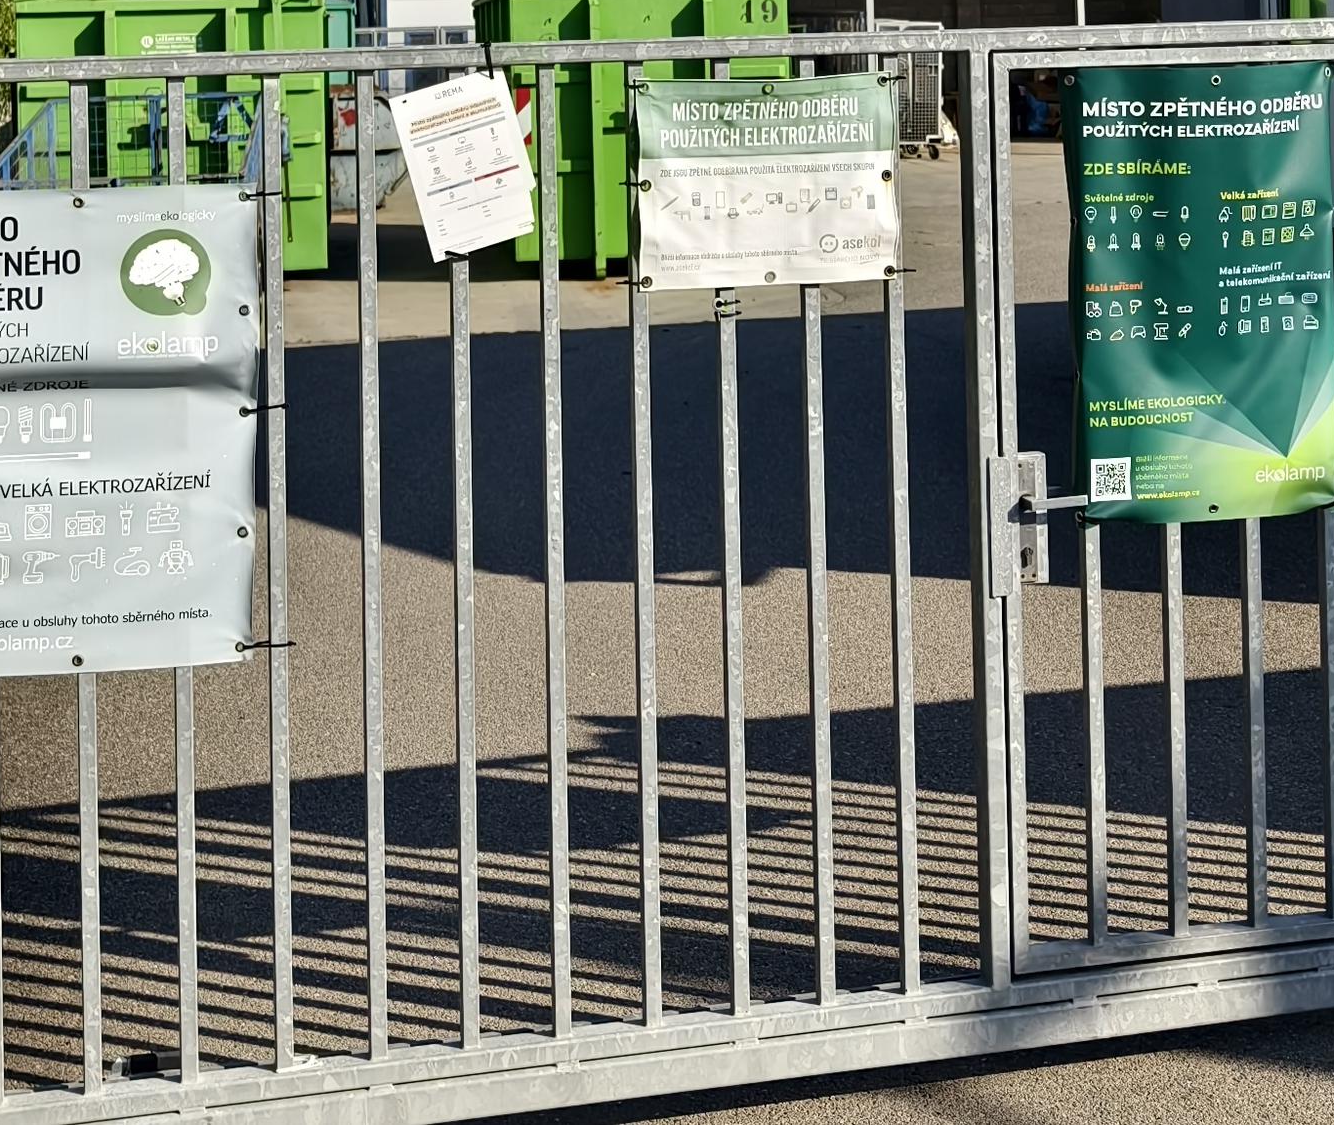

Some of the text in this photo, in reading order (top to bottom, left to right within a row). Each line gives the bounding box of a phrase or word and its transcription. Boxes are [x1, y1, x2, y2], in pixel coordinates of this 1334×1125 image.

[740, 0, 778, 23] 19
[442, 86, 463, 98] REMA
[672, 94, 859, 122] MÍSTO ZPĚTNÉHO ODBĚRU
[1082, 91, 1323, 118] MÍSTO ZPĚTNÉHO ODBĚRU
[660, 121, 874, 149] POUŽITÝCH ELEKTROZAŘÍZENÍ
[1082, 115, 1300, 138] POUŽITÝCH ELEKTROZAŘÍZENÍ
[1084, 159, 1192, 176] ZDE SBÍRÁME:
[1084, 194, 1155, 203] Světelné zdroje
[842, 235, 881, 249] asekol
[117, 331, 219, 356] ekolamp
[23, 379, 90, 392] ZDROJE
[1089, 397, 1145, 412] MYSLÍME
[1089, 412, 1194, 427] NA BUDOUCNOST
[1255, 465, 1325, 483] ekolamp
[0, 478, 53, 499] VELKÁ
[59, 470, 212, 496] ELEKTROZAŘÍZENÍ
[22, 619, 30, 627] u
[33, 615, 77, 629] obsluhy
[81, 613, 119, 625] tohoto
[122, 609, 175, 624] sběrného
